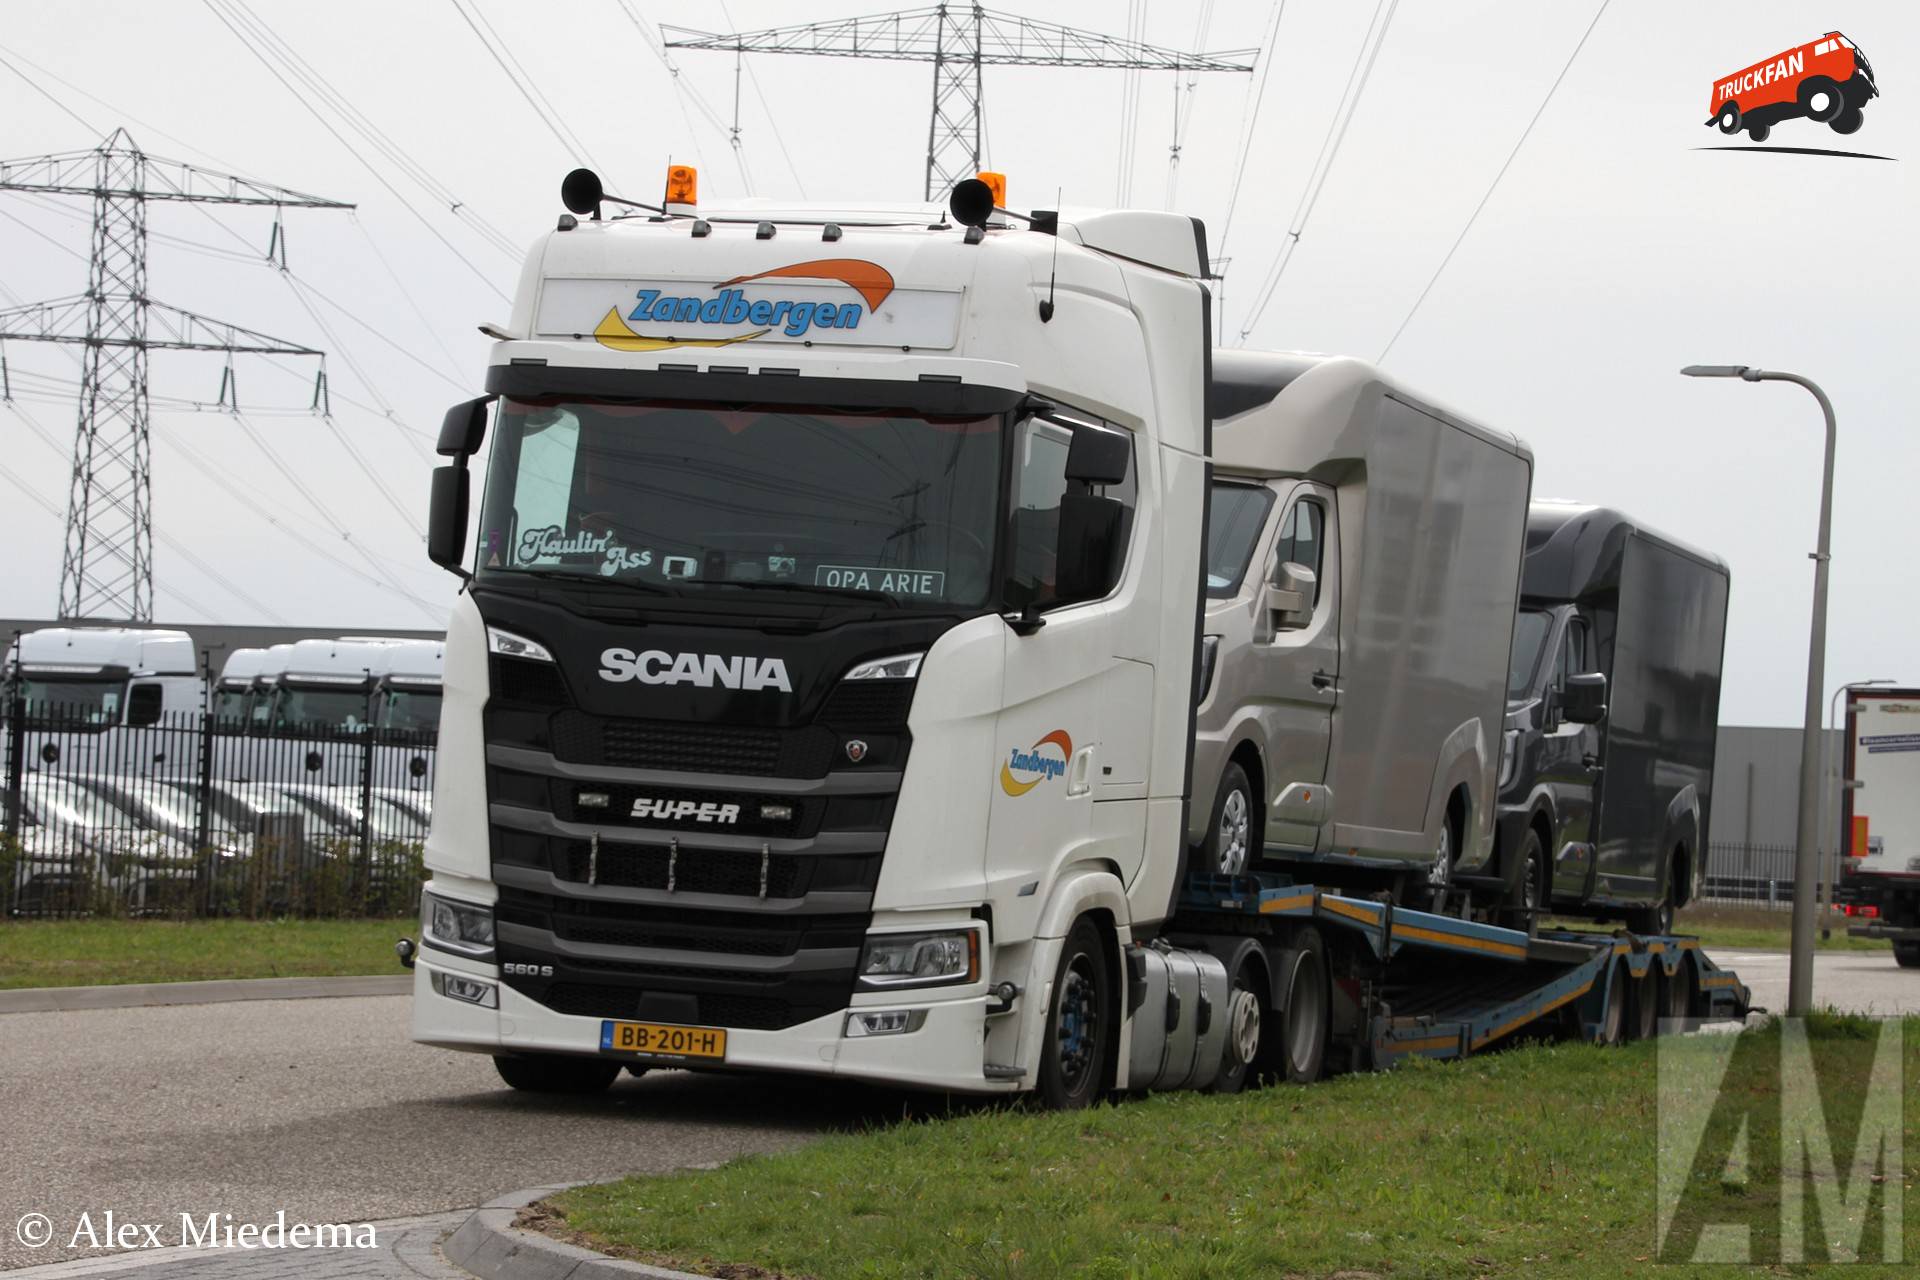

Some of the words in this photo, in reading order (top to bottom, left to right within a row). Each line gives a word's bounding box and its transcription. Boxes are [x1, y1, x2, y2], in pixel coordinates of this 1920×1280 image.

[628, 289, 863, 337] Zandbergen
[519, 525, 614, 561] Haulin'
[600, 546, 652, 577] Ass
[826, 570, 871, 591] OPA
[879, 573, 933, 595] ARIE
[599, 647, 793, 693] SCANIA
[1009, 748, 1066, 781] Zandbergen
[630, 798, 741, 824] SUPER
[503, 962, 540, 976] 560
[541, 965, 554, 977] S
[621, 1026, 716, 1053] BB-201-H
